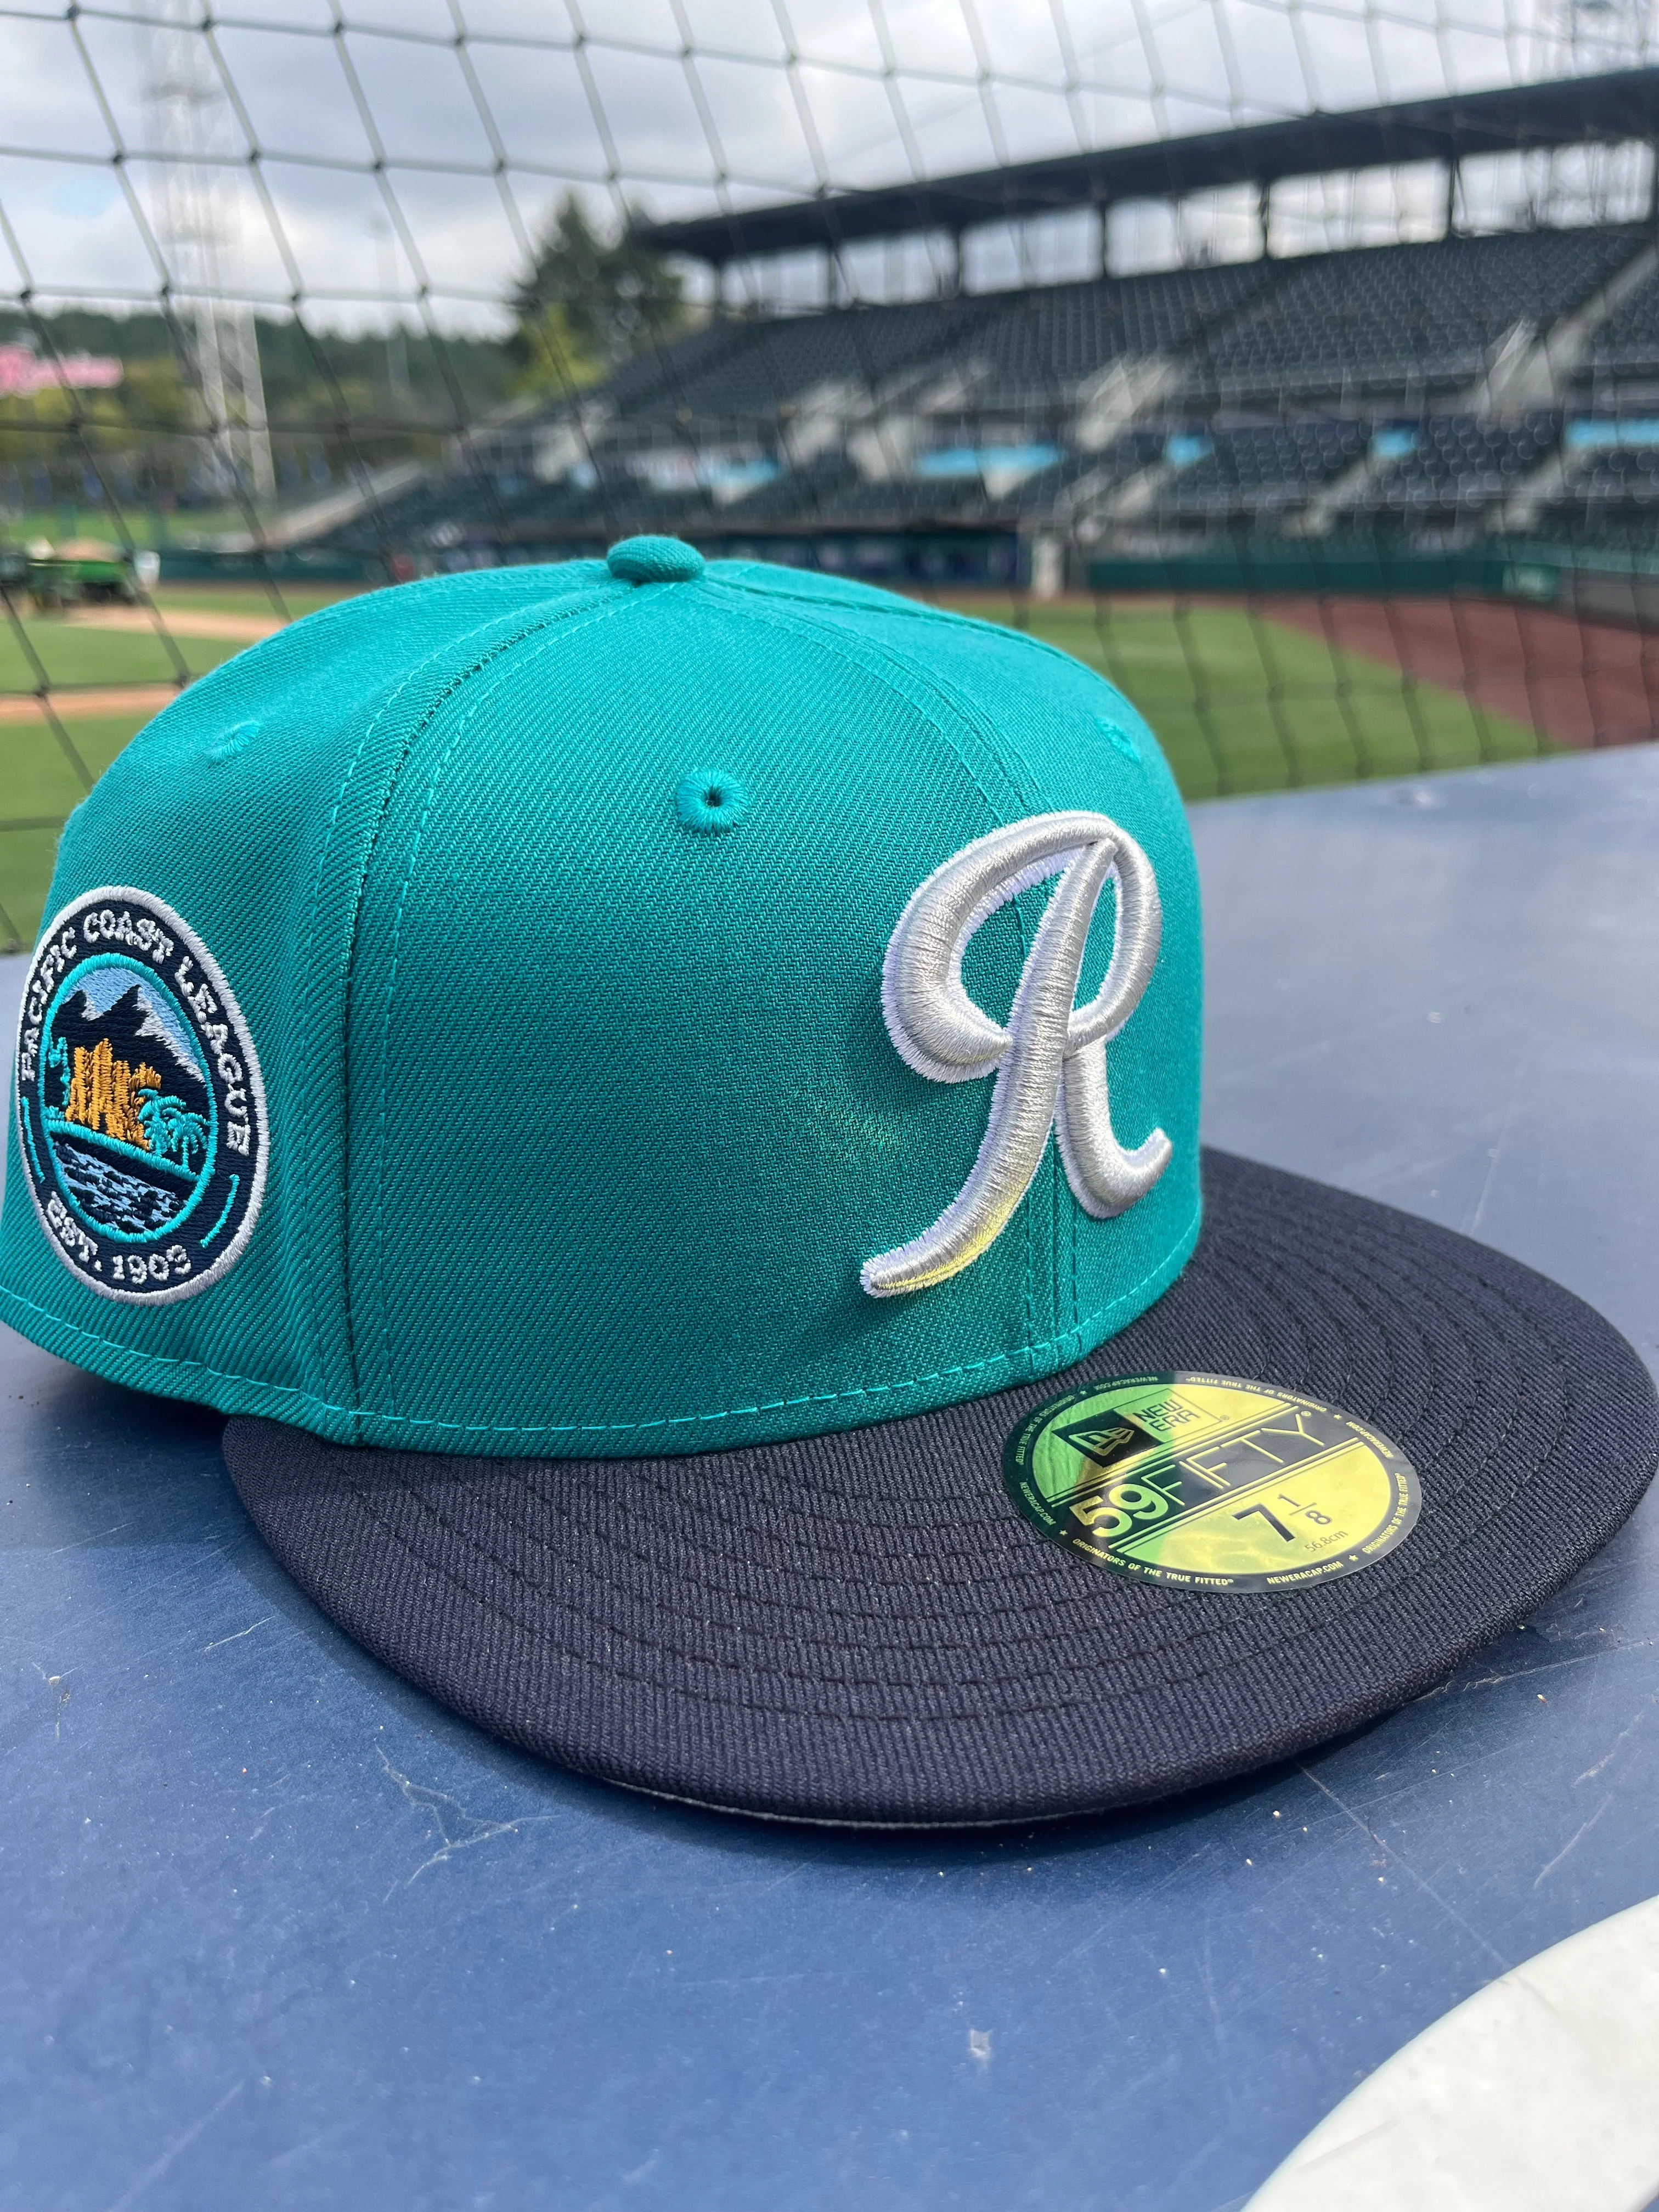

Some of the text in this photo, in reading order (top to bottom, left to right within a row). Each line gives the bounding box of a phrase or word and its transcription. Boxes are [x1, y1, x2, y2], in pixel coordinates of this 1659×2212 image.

[21, 910, 250, 1156] PACIFIC COAST LEAGUE
[859, 811, 1172, 1298] R
[47, 1191, 191, 1285] EST. 1903
[1132, 1400, 1183, 1421] NEW
[1150, 1409, 1200, 1432] ERA
[1019, 1482, 1056, 1526] NEWERACAP.COM
[1232, 1502, 1296, 1542] 7
[1073, 1538, 1126, 1566] ORIGINATORS
[1127, 1562, 1141, 1571] OF
[1143, 1566, 1162, 1577] THE
[1166, 1572, 1190, 1583] TRUE
[1304, 1530, 1349, 1553] 56.8cm
[1266, 1561, 1344, 1584] NEWERACAP.COM
